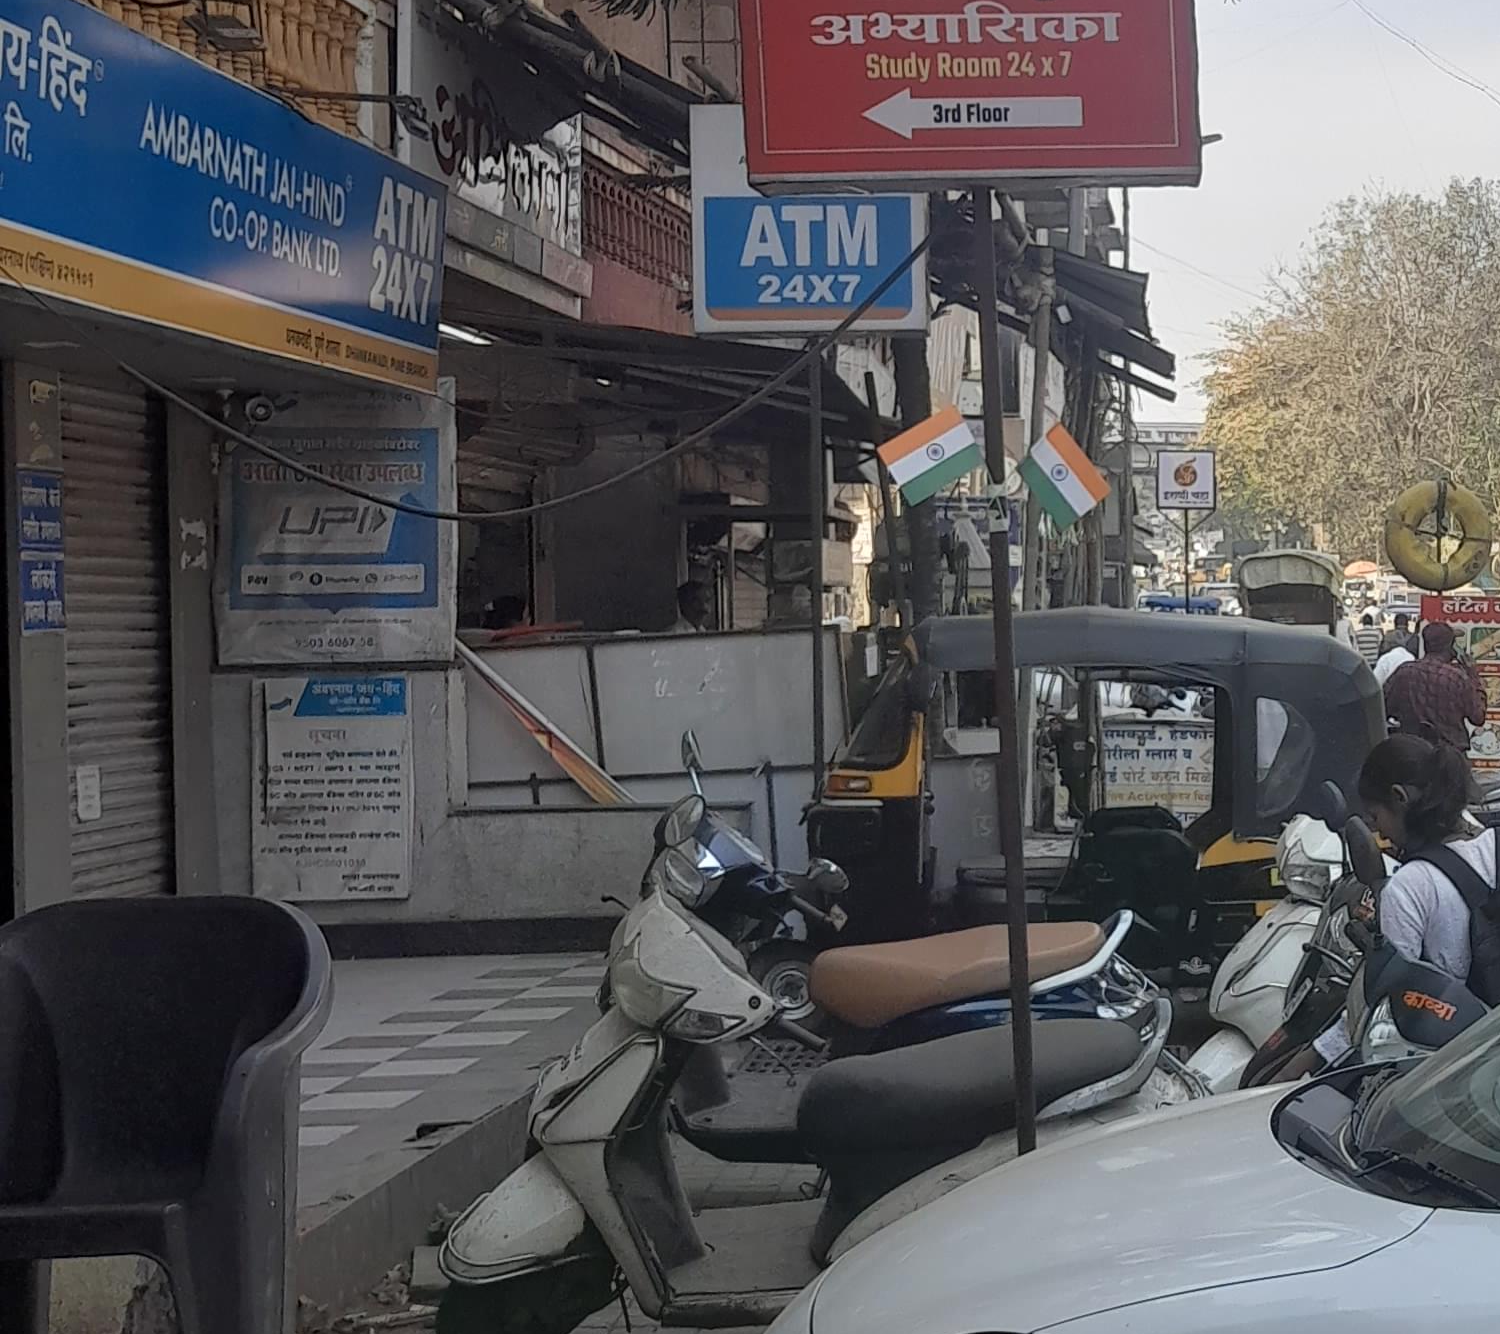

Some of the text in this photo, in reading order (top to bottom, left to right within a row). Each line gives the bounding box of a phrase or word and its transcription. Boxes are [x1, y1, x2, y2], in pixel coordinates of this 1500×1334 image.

[810, 0, 1123, 46] अभ्यासिका
[865, 50, 1073, 83] Study Room 24 x 7
[932, 102, 1011, 125] 3rd Floor
[139, 100, 267, 200] AMBARNATH
[270, 157, 347, 228] JAI-HIND
[209, 196, 342, 279] CO-OP. BANK LTD.
[372, 175, 439, 262] ATM
[740, 204, 879, 267] ATM
[368, 244, 434, 326] 24X7
[757, 274, 862, 304] 24X7
[278, 505, 370, 535] UPI
[1441, 596, 1490, 615] हॉटेल
[1403, 990, 1458, 1021] काव्या
